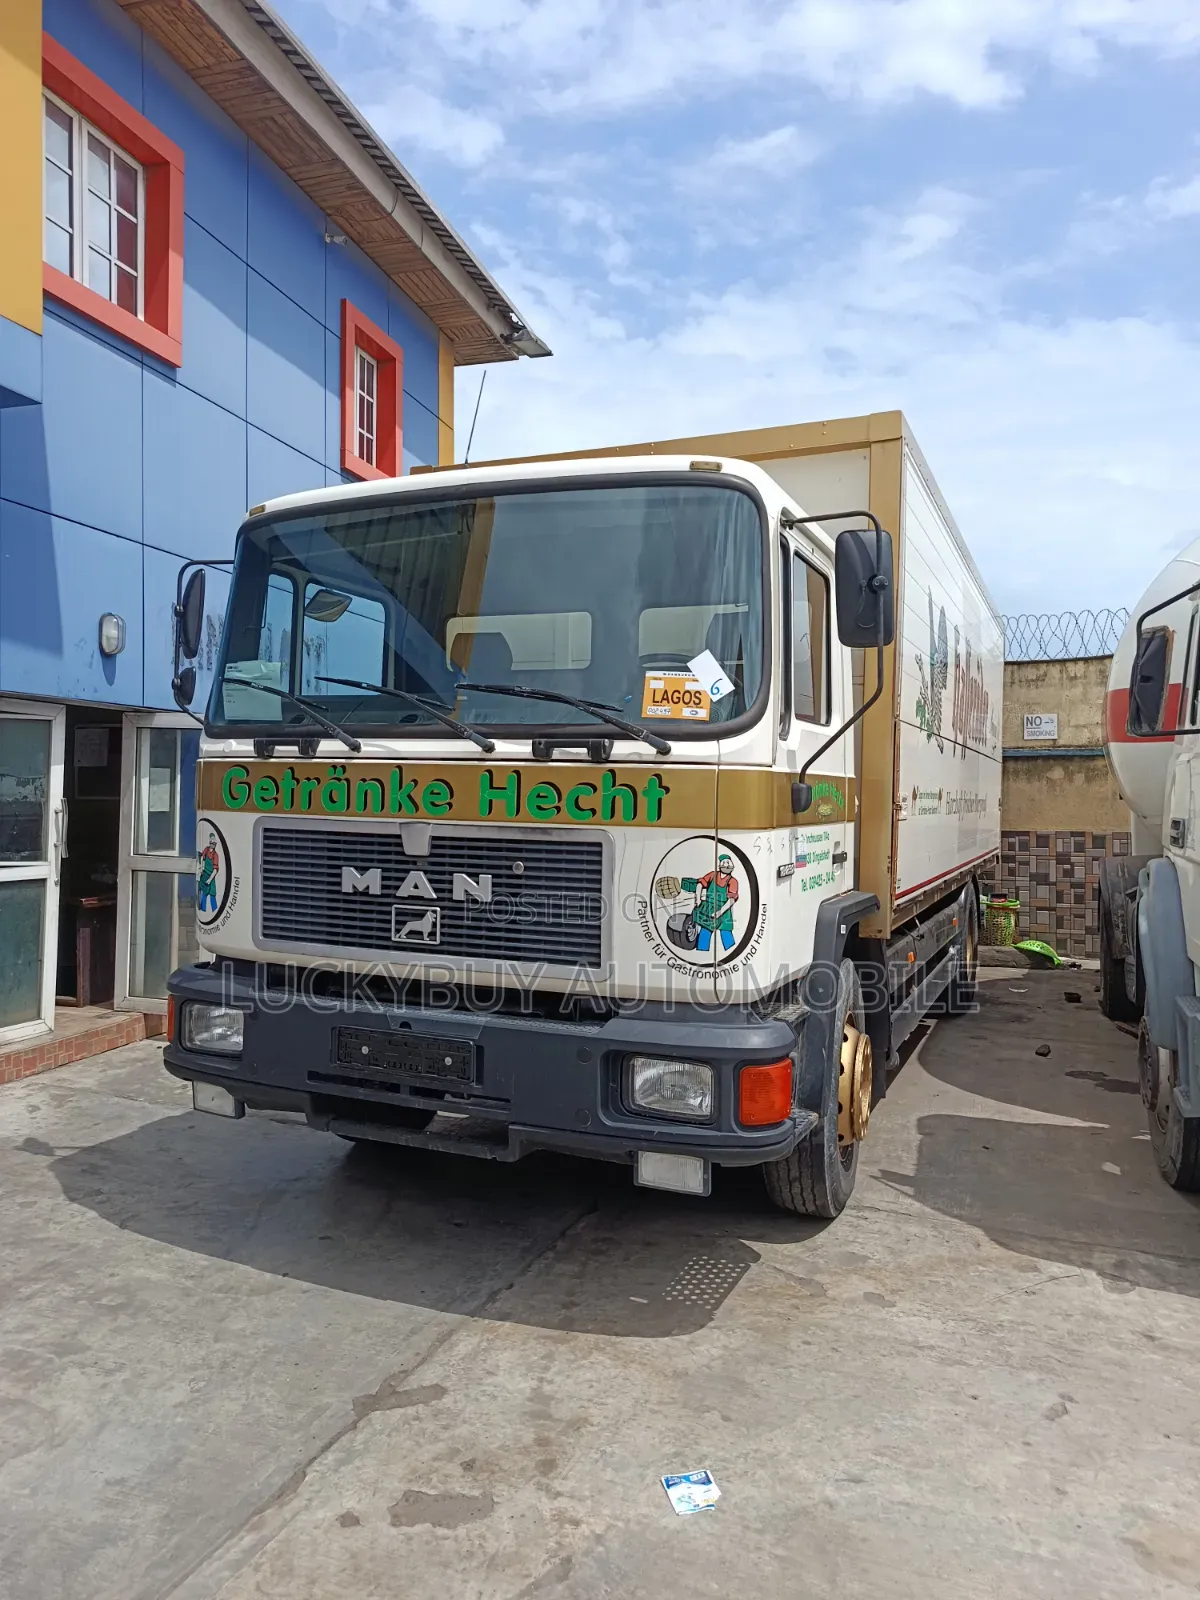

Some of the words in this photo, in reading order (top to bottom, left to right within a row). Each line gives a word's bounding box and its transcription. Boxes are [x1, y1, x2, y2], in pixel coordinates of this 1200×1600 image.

[652, 689, 702, 705] LAGOS
[1026, 716, 1042, 727] NO
[222, 764, 454, 816] Getränke
[479, 768, 670, 823] Hecht
[220, 909, 232, 927] und
[228, 876, 241, 912] Handel
[341, 865, 493, 901] MAN
[637, 900, 655, 943] Partner
[652, 943, 667, 960] für
[666, 957, 740, 980] Gastronomie
[740, 947, 758, 967] und
[754, 903, 767, 945] Handel
